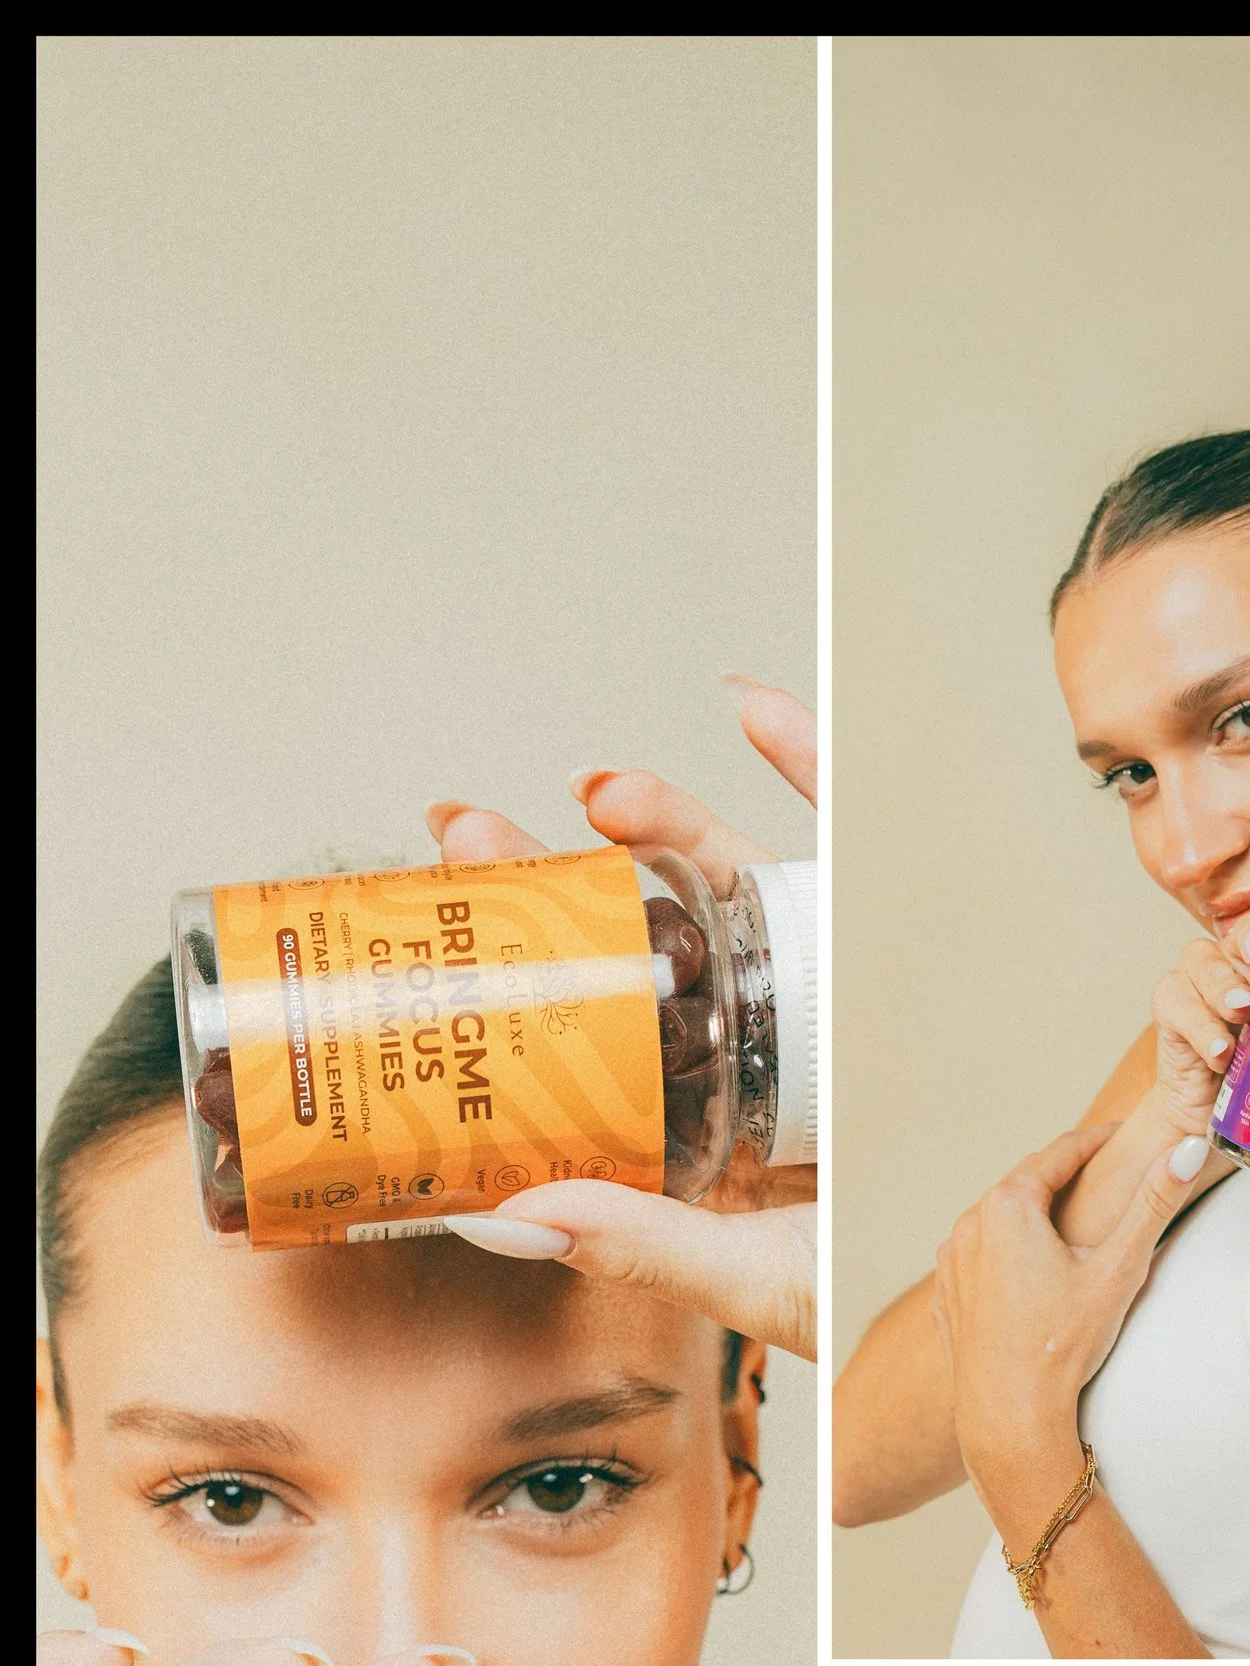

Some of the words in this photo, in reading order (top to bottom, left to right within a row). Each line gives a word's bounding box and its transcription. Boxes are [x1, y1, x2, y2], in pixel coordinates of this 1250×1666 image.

[282, 935, 294, 950] 90
[309, 912, 331, 984] DIETARY
[284, 952, 302, 1020] GUMMIES
[501, 944, 524, 1057] EcoLuxe
[339, 912, 352, 949] CHERRY
[352, 1032, 371, 1135] ASHWAGANDHA
[368, 938, 405, 1091] GUMMIES
[402, 940, 444, 1082] FOCUS
[437, 901, 492, 1123] BRINGME
[292, 1024, 305, 1054] PER
[295, 1058, 312, 1117] BOTTLE
[318, 997, 347, 1142] SUPPLEMENT
[377, 1175, 387, 1190] Dye
[391, 1177, 400, 1196] GMO
[475, 1169, 486, 1193] Vegan
[550, 1161, 560, 1182] Heal
[563, 1160, 572, 1180] Kidn
[292, 1193, 300, 1209] Free
[305, 1189, 314, 1209] Dairy
